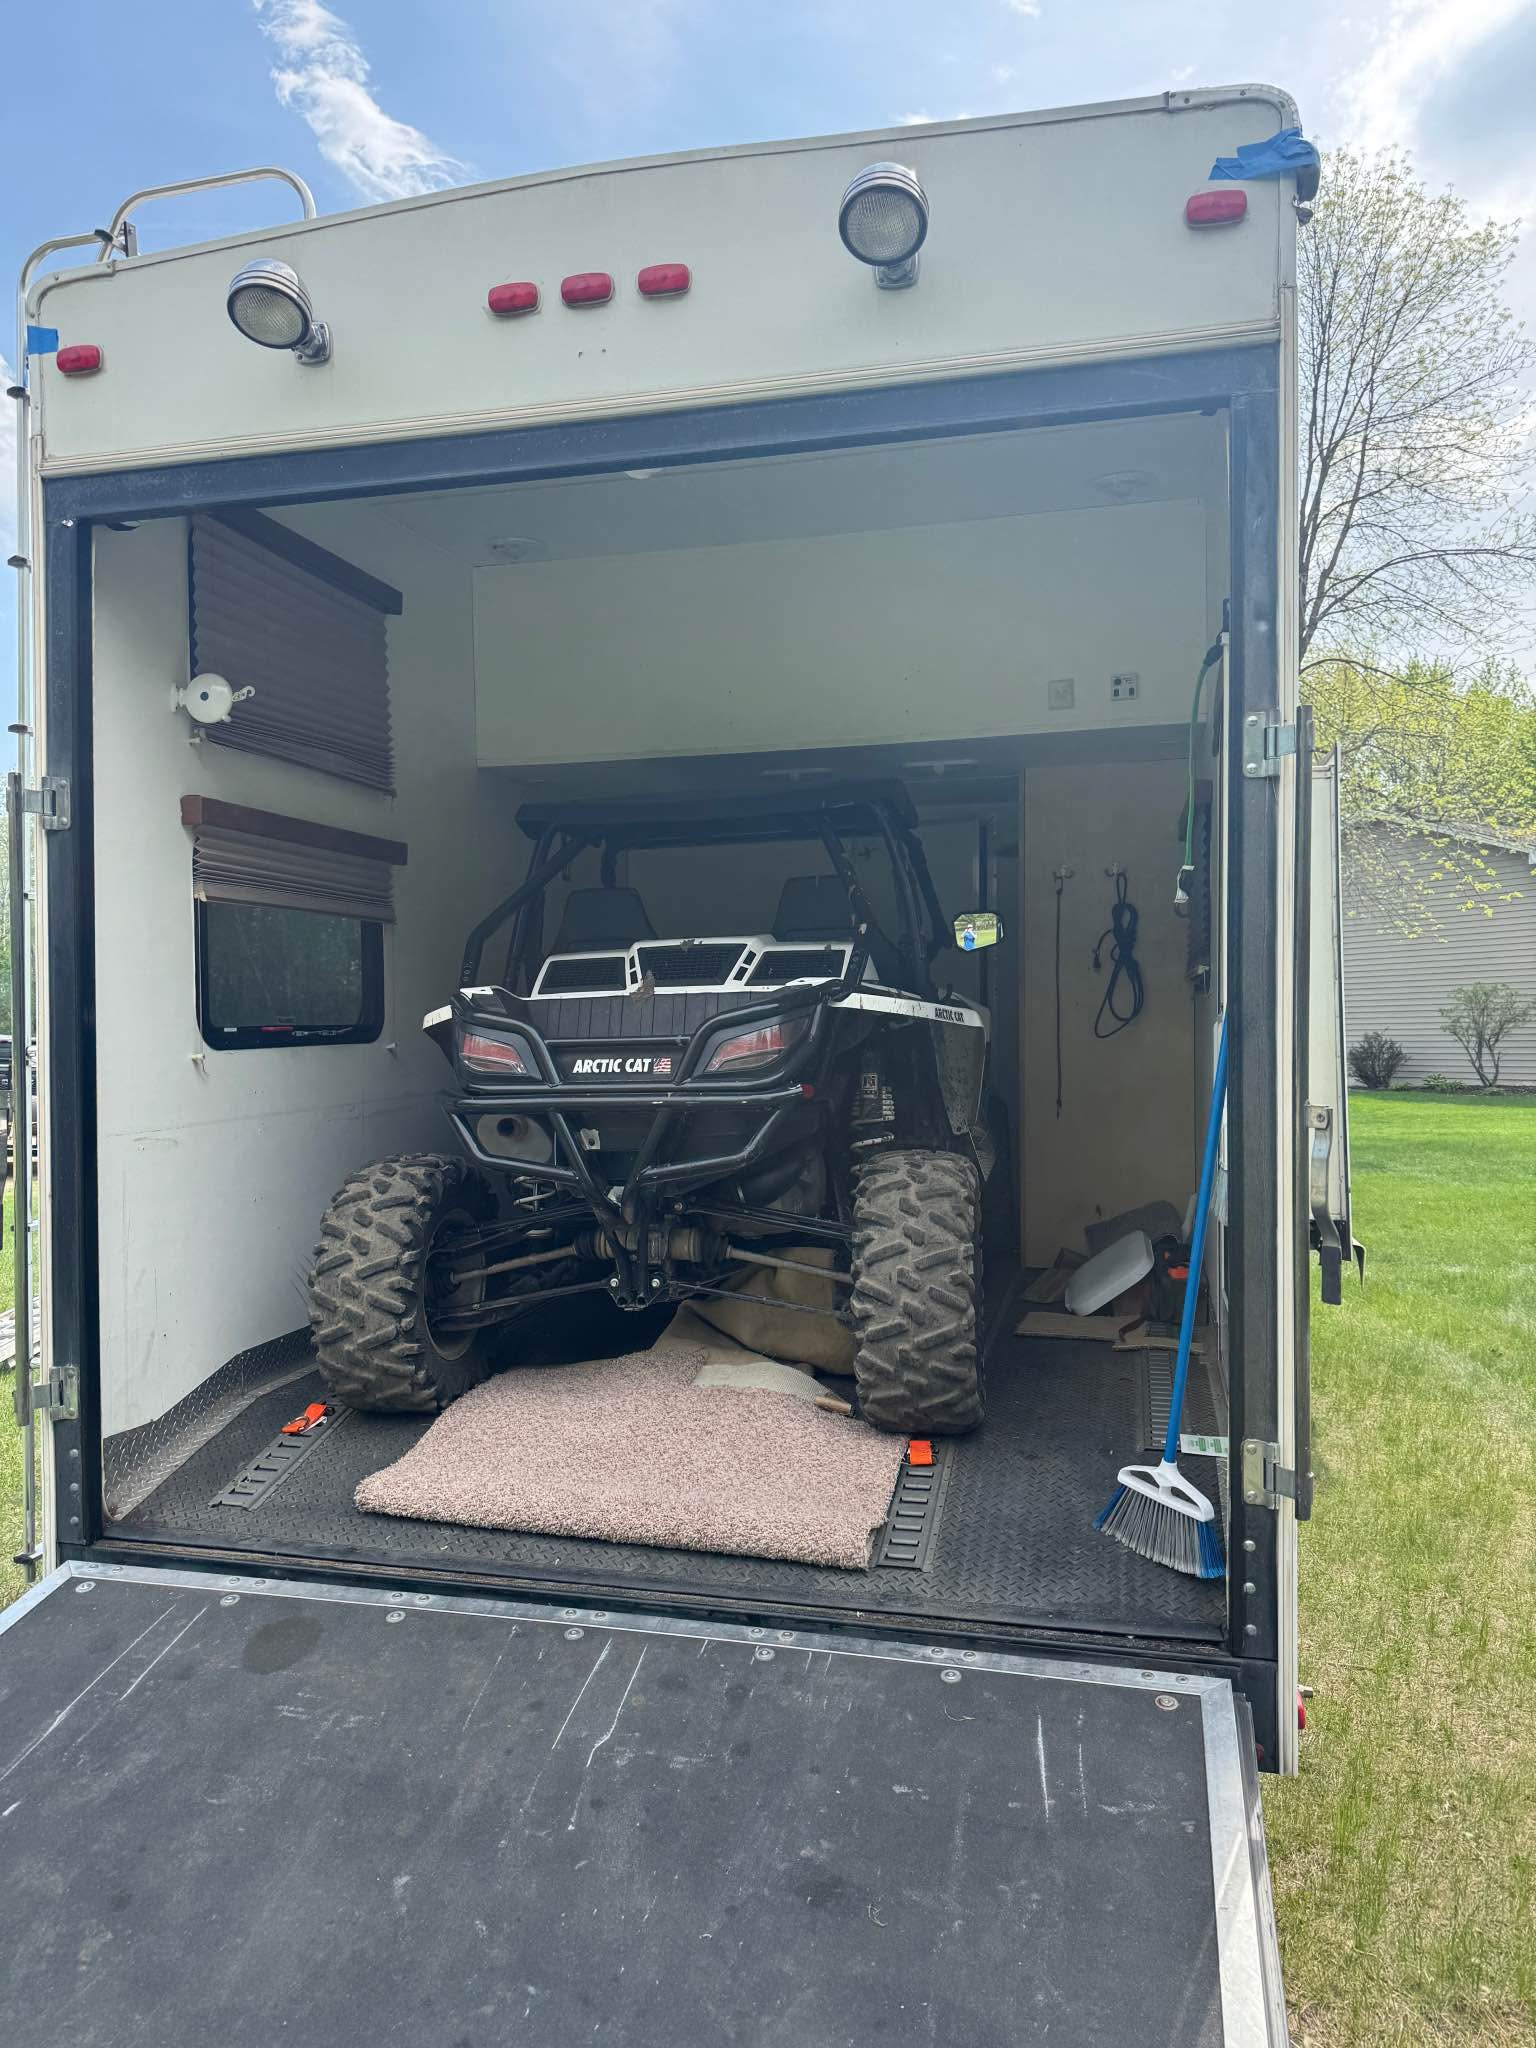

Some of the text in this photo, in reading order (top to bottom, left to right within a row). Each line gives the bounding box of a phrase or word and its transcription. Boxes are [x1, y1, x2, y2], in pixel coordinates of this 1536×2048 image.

[934, 1007, 965, 1023] ARCTIC CAT
[572, 1058, 651, 1073] ARCTIC CAT
